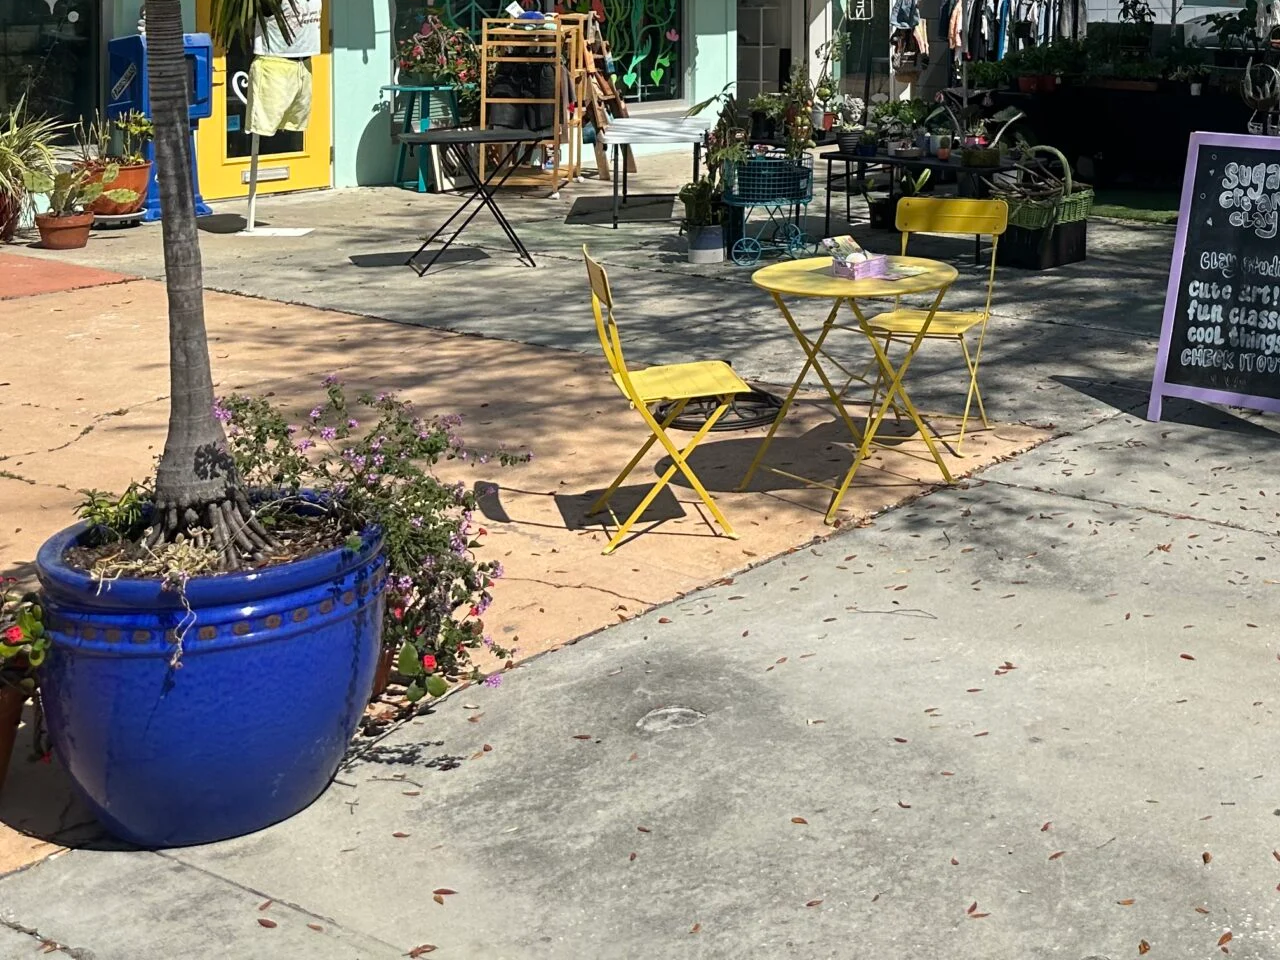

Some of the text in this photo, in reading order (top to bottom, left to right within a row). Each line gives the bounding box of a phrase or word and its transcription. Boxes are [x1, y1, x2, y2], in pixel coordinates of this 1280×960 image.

[1187, 299, 1224, 323] fun
[1180, 347, 1235, 371] CHECK
[1239, 352, 1256, 372] IT
